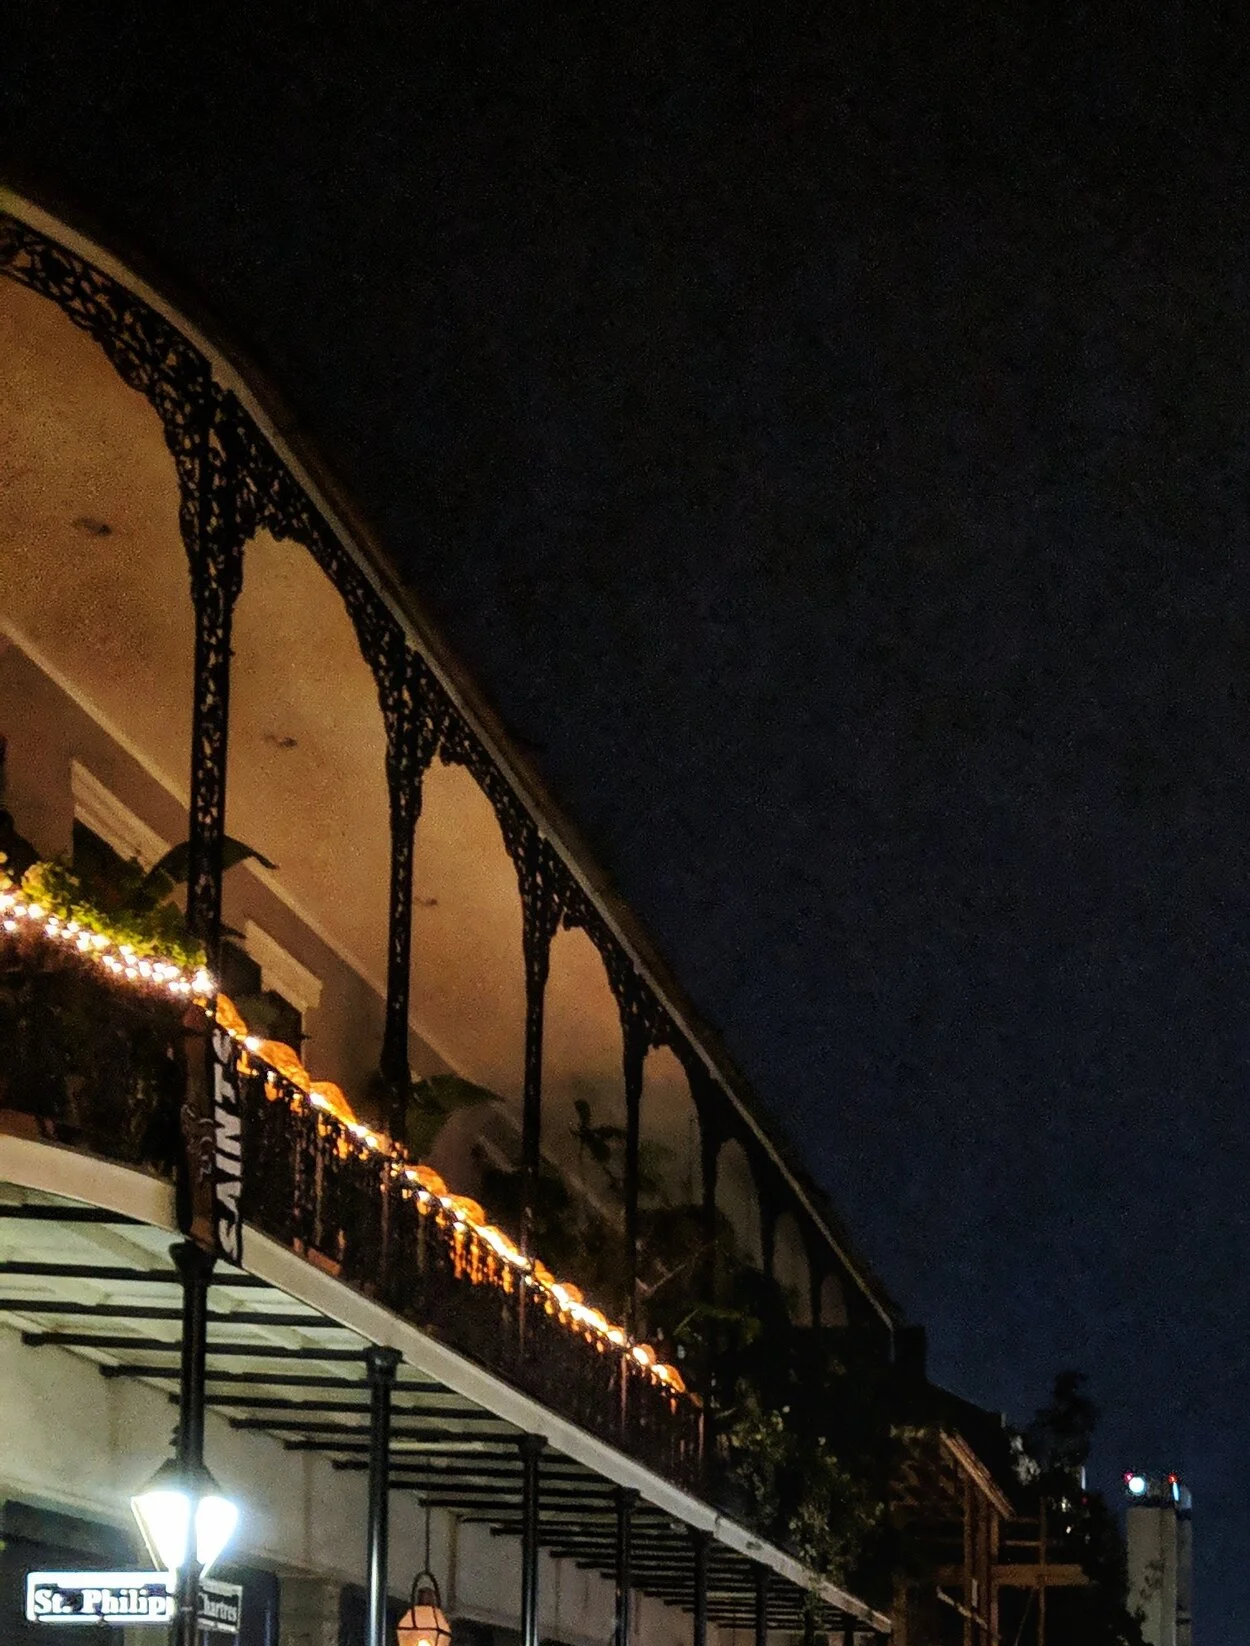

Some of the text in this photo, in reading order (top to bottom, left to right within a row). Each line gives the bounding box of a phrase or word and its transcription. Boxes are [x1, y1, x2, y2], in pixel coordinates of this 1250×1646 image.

[212, 1027, 242, 1262] SAINTS
[34, 1588, 166, 1616] St. Philip
[199, 1592, 238, 1622] hartres
